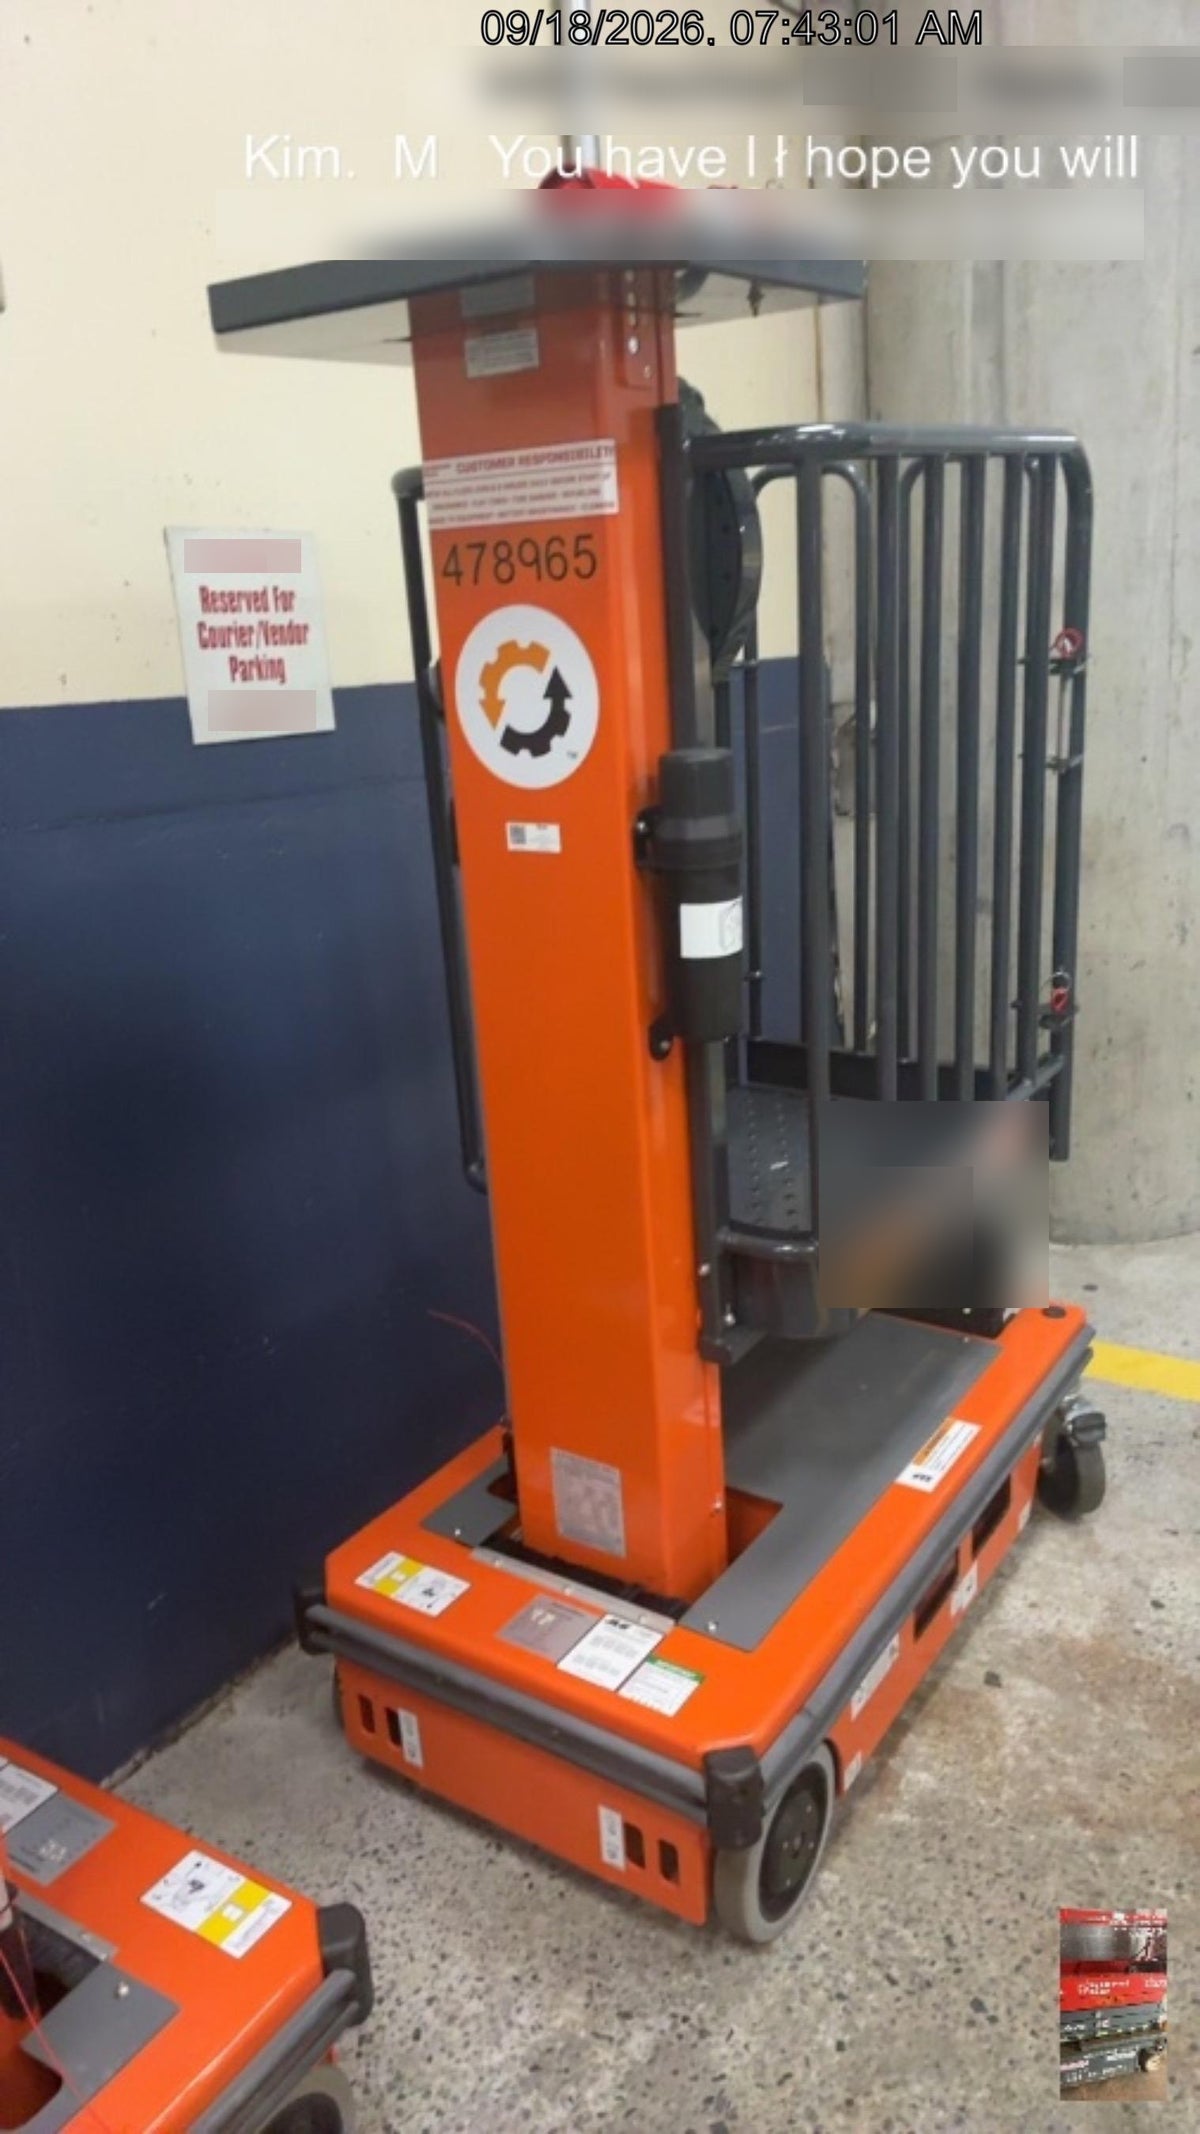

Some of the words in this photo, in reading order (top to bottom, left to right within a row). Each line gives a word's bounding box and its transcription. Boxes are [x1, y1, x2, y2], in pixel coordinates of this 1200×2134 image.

[442, 532, 597, 587] 478965
[198, 585, 270, 614] Reserved
[272, 585, 296, 613] For
[229, 654, 286, 685] Parking
